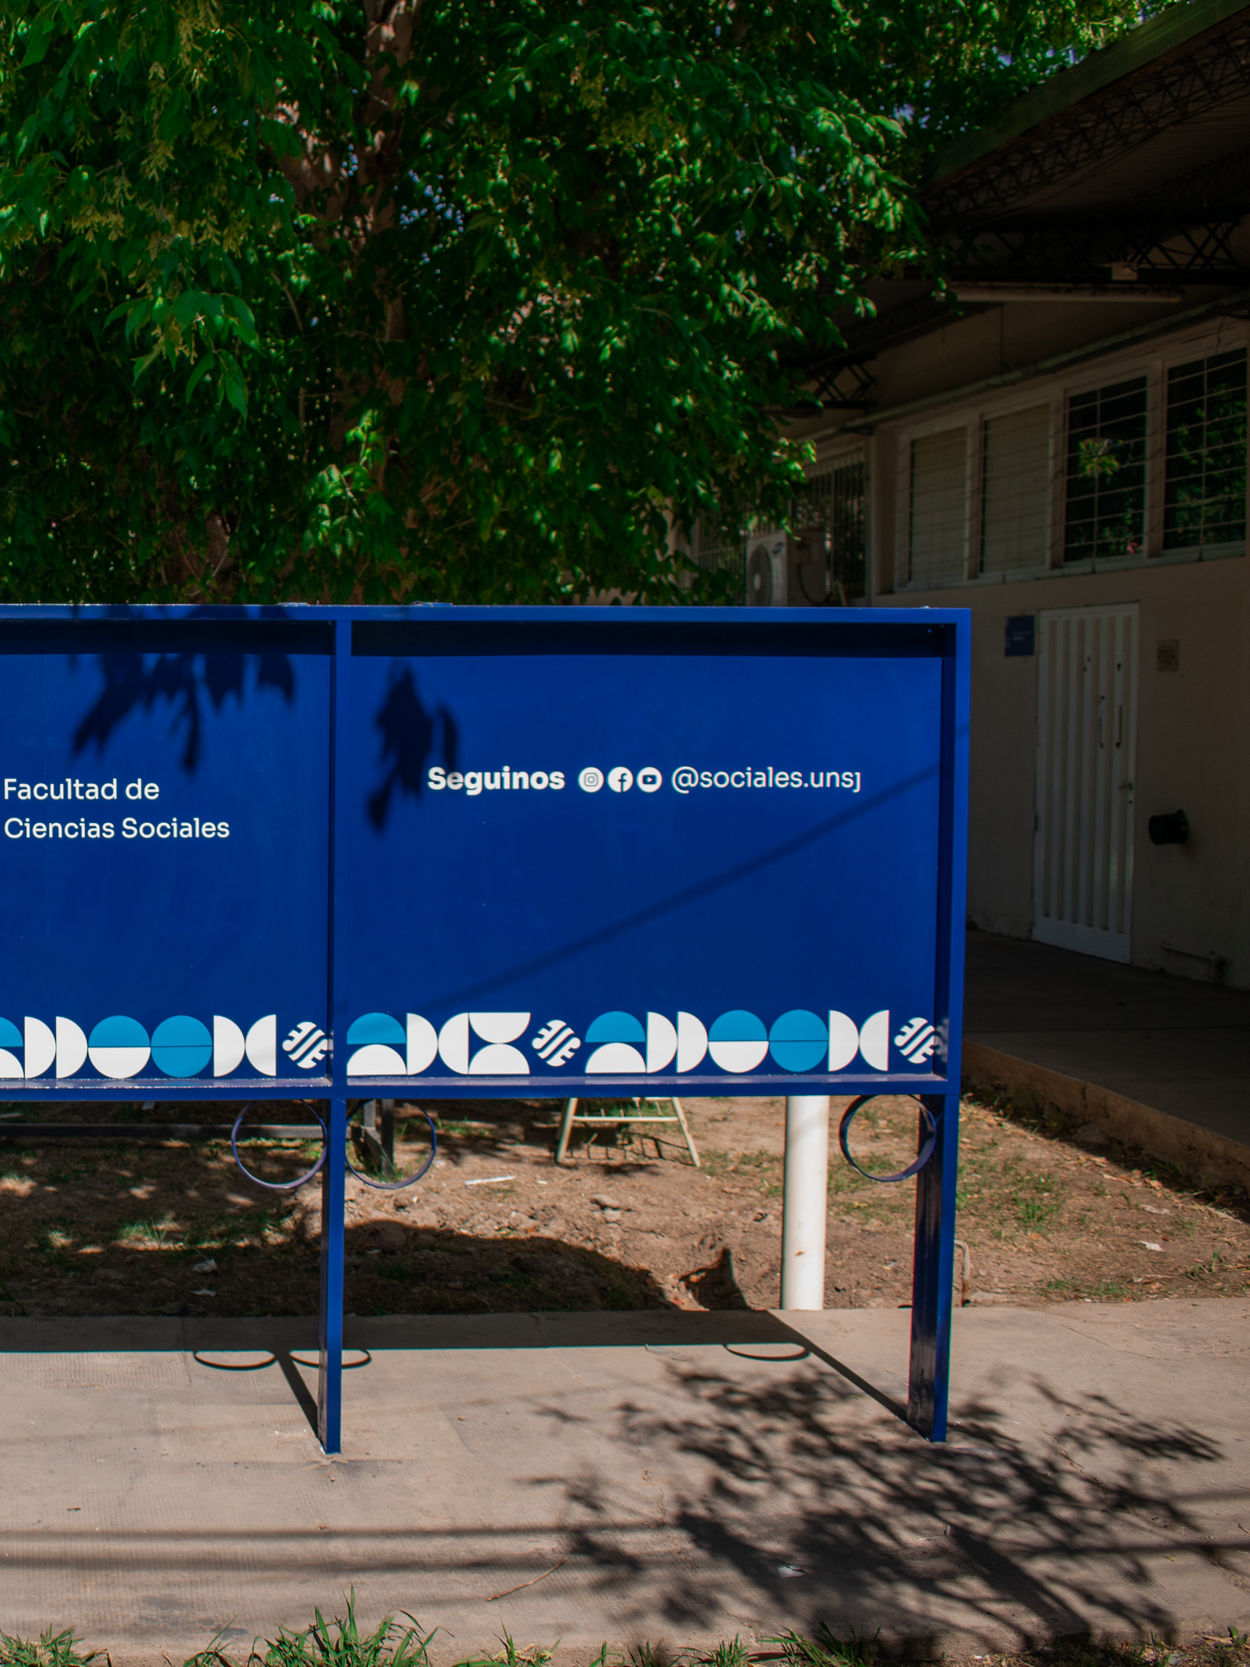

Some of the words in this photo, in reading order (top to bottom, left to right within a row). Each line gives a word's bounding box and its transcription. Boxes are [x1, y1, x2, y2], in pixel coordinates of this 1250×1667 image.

[4, 777, 118, 801] Facultad
[125, 777, 160, 801] de
[427, 765, 566, 796] Seguinos
[671, 766, 861, 794] @sociales.unsj
[4, 817, 115, 839] Ciencias
[121, 817, 230, 839] Sociales
